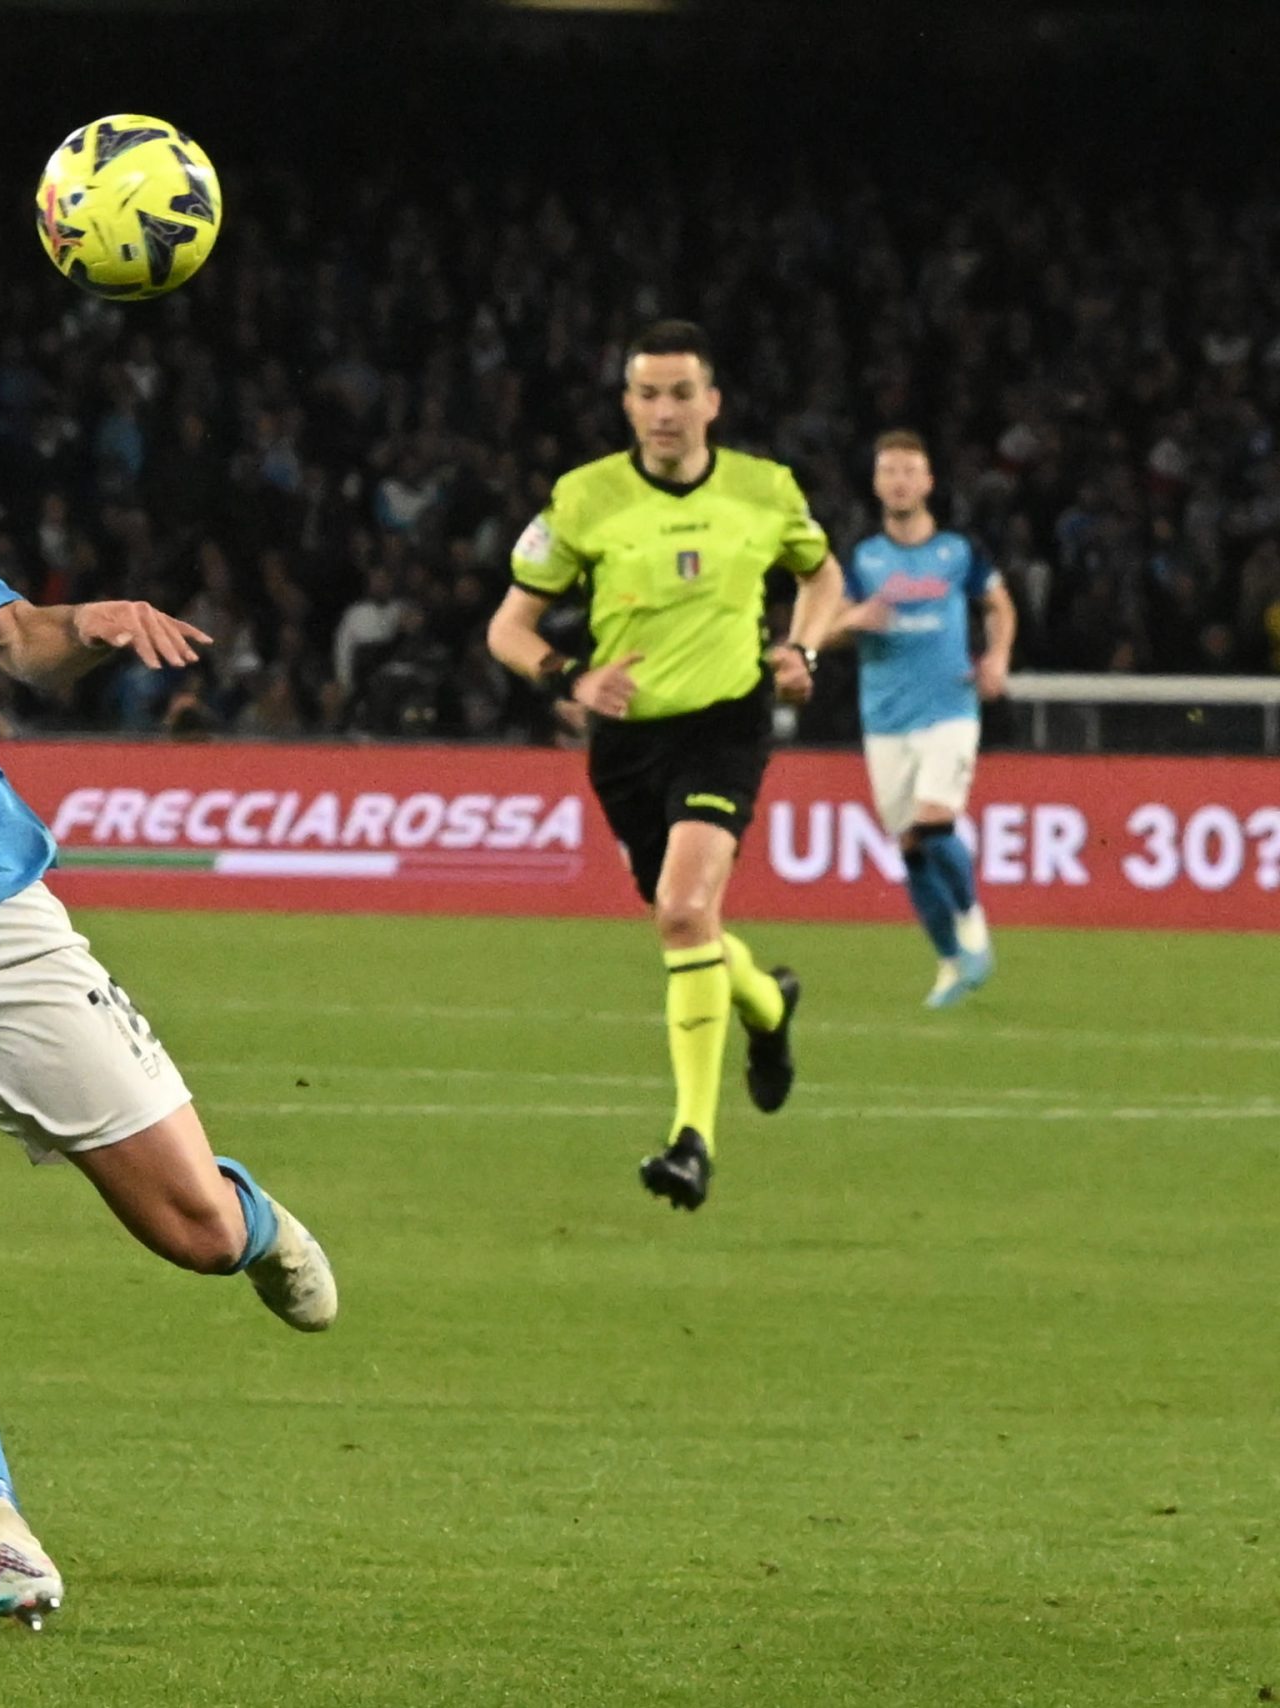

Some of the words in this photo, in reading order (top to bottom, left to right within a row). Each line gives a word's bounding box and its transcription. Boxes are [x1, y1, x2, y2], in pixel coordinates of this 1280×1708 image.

[51, 787, 585, 849] FRECCIAROSSA
[768, 800, 1091, 886] UNER
[1122, 803, 1280, 890] 30?
